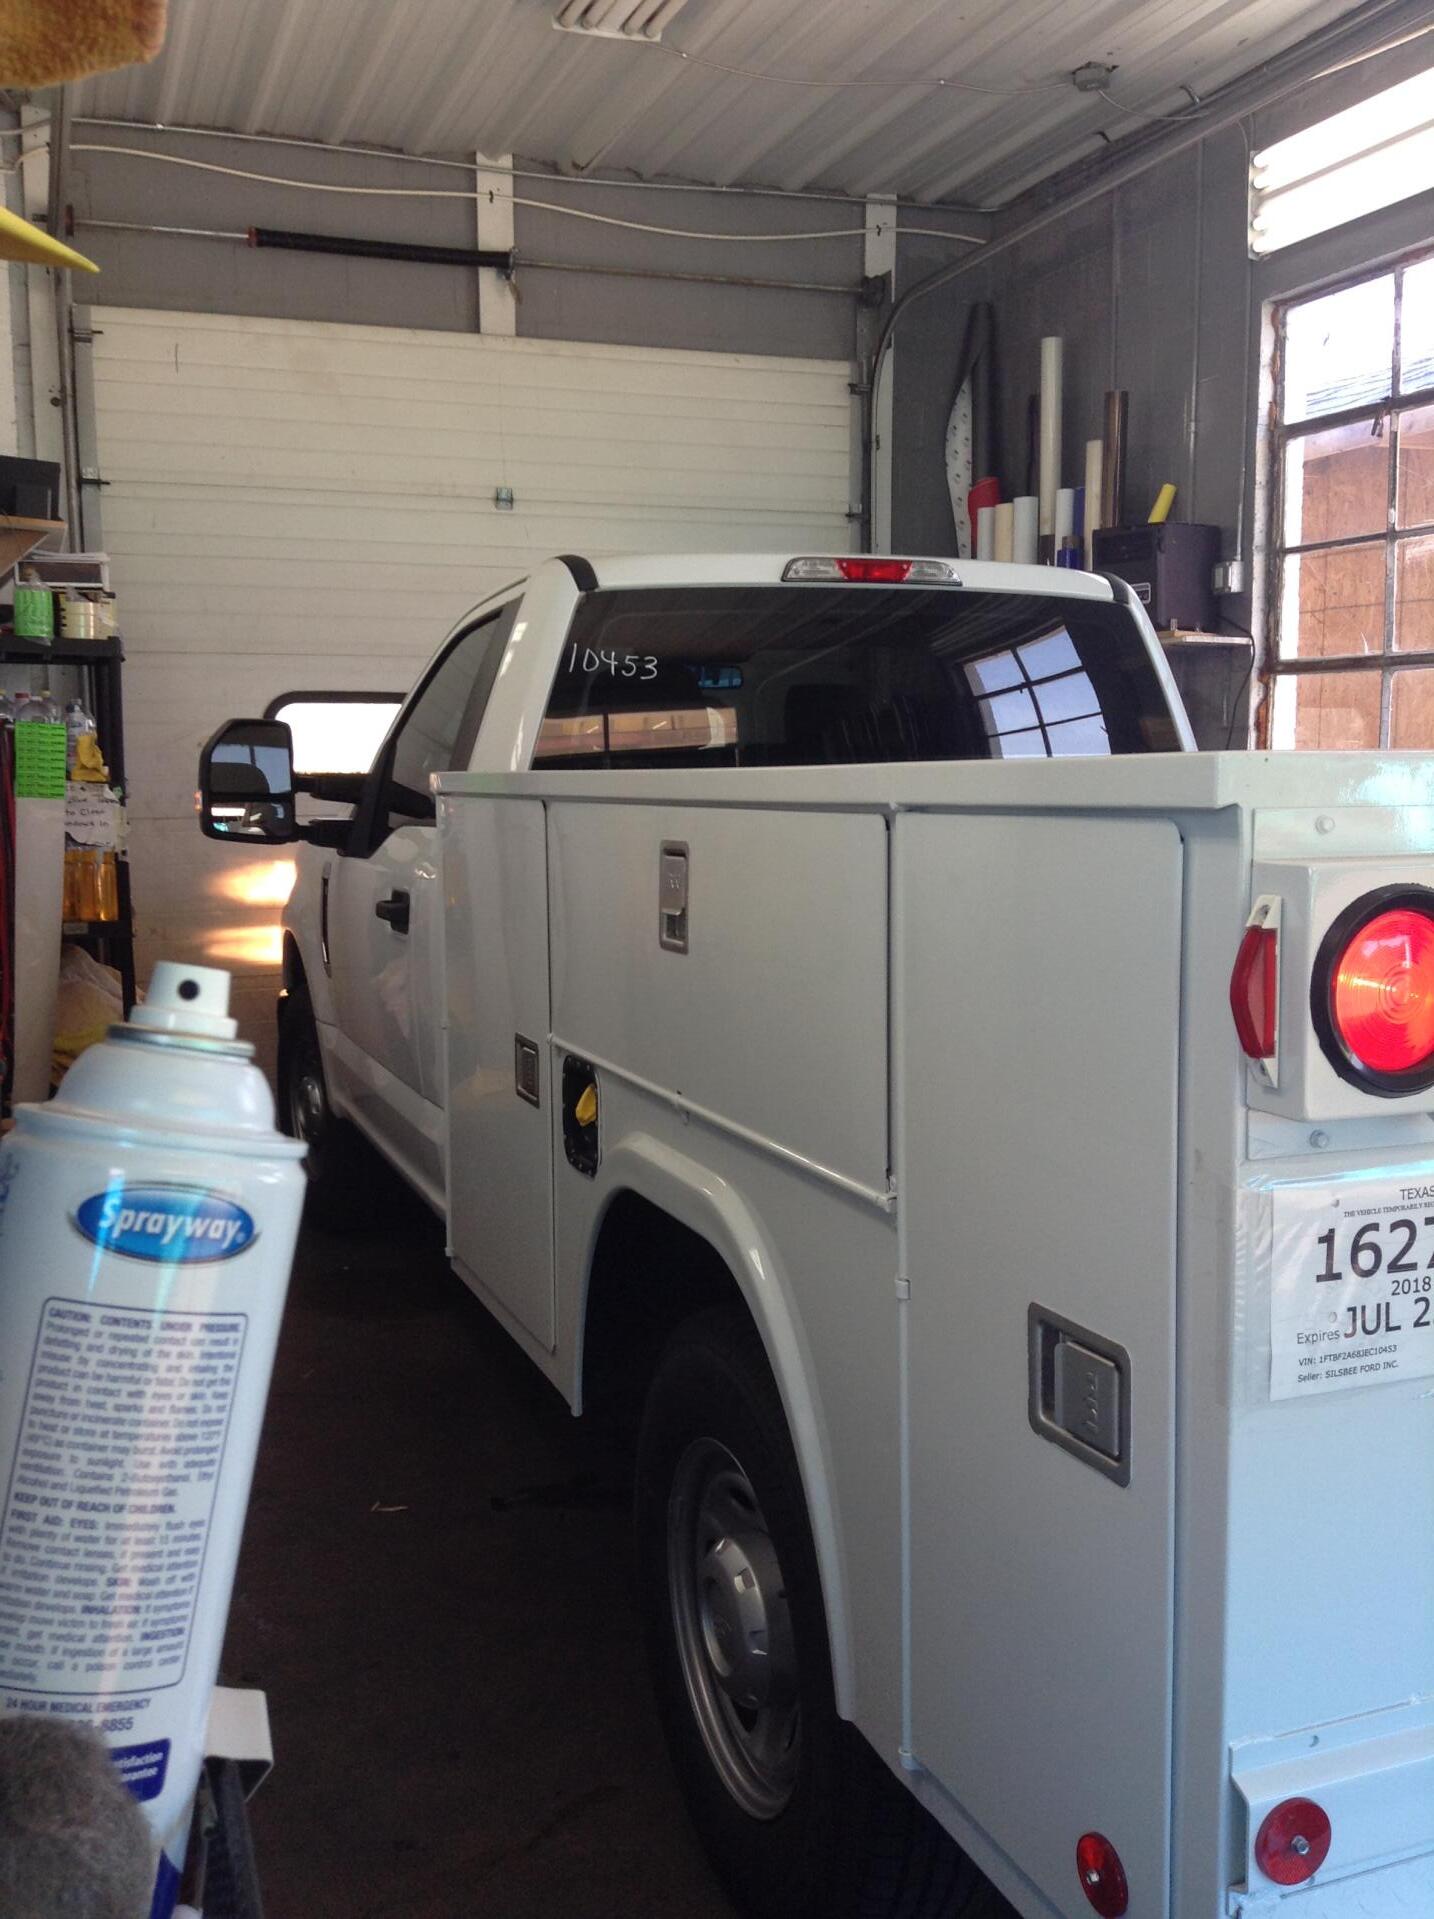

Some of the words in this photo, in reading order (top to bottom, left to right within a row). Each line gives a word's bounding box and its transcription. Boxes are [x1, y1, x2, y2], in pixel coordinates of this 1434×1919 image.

[568, 642, 658, 680] 10453
[1400, 1185, 1434, 1201] TEXAS
[98, 1198, 242, 1249] Sprayway
[1391, 1276, 1431, 1296] 2018
[1297, 1329, 1340, 1345] Expires
[1344, 1302, 1402, 1339] JUL
[1413, 1297, 1434, 1328] 2
[1298, 1371, 1323, 1383] Seller:
[1325, 1366, 1358, 1379] SILSBEE
[1359, 1362, 1381, 1374] FORD
[1382, 1359, 1400, 1370] INC.
[1299, 1357, 1317, 1367] VIN:
[20, 1699, 46, 1709] HOUR
[50, 1700, 92, 1711] MEDICAL
[97, 1700, 150, 1711] EMERGENCY
